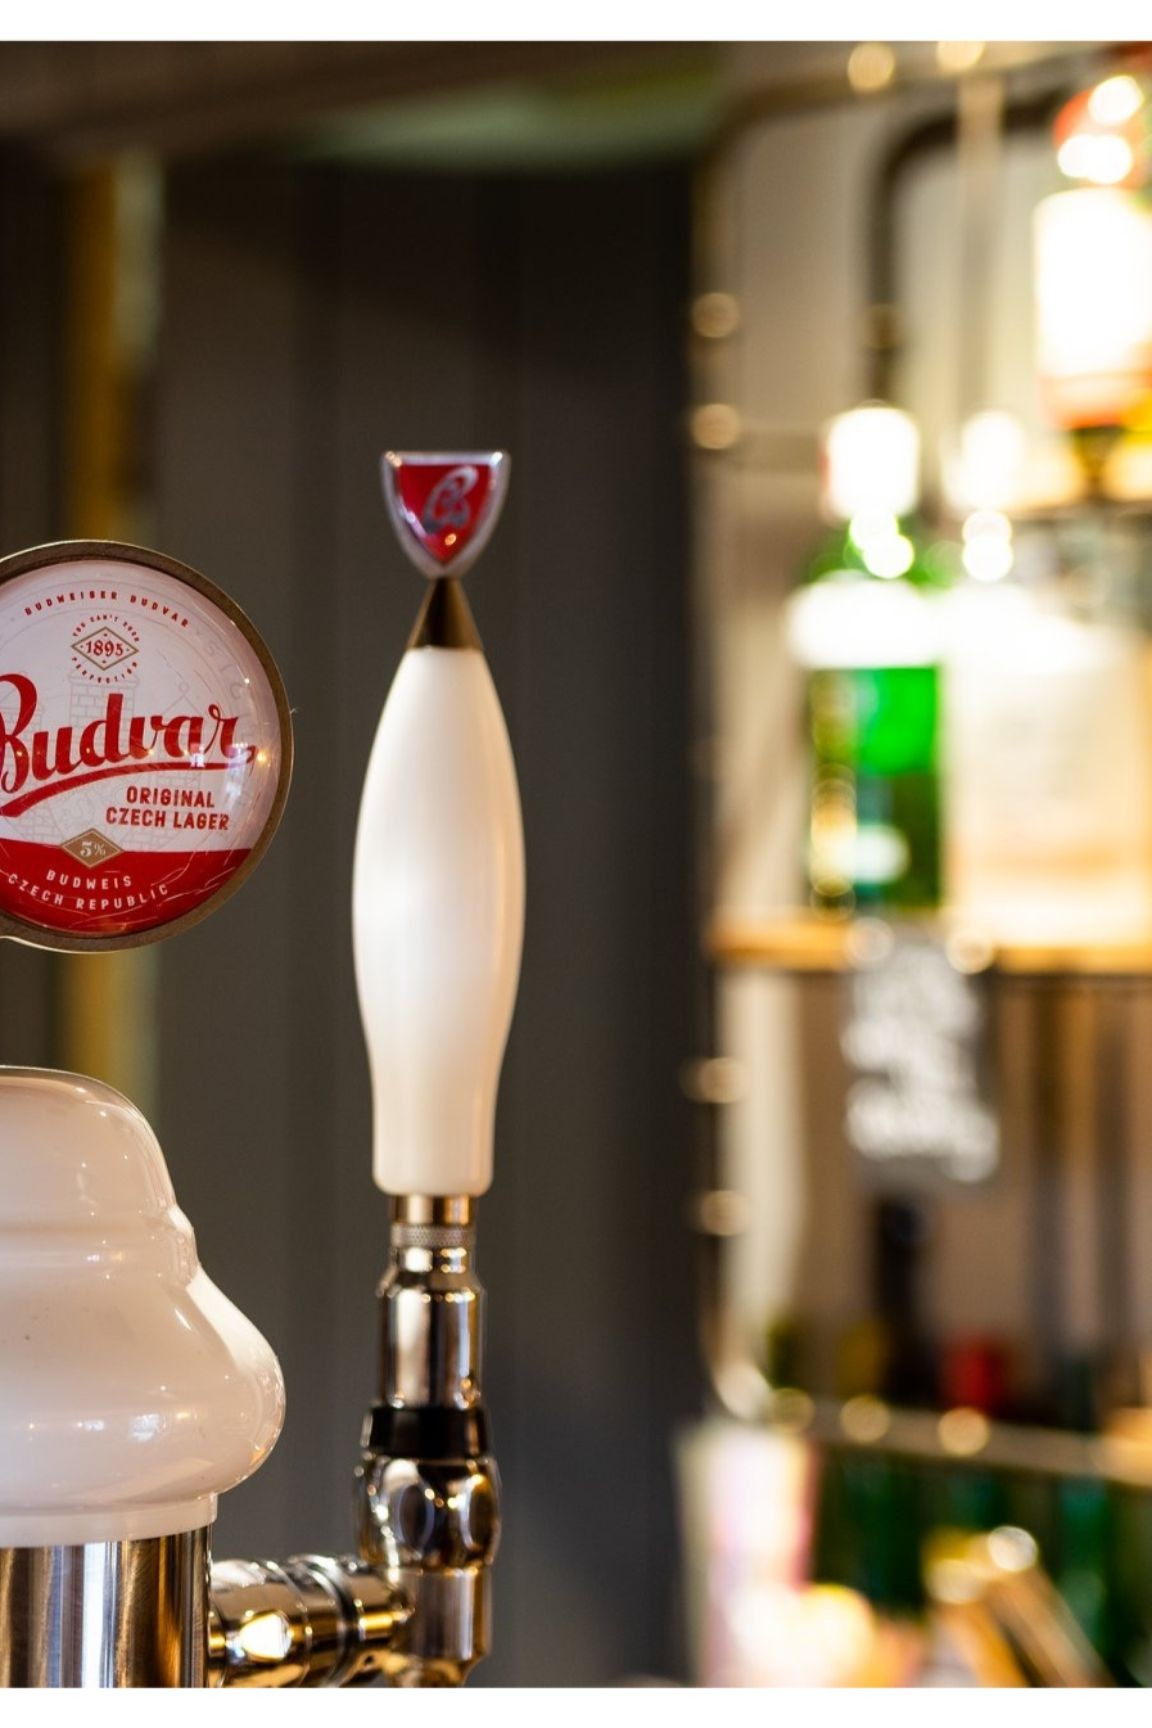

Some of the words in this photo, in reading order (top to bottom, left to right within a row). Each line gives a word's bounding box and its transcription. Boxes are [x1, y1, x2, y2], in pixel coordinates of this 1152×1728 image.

[24, 590, 118, 616] BUDWEISER
[130, 594, 189, 628] BUDVAR
[85, 639, 124, 657] 1895
[126, 785, 215, 808] ORIGINAL
[106, 806, 166, 828] CZECH
[173, 811, 230, 831] LAGER
[79, 840, 106, 858] 5%
[46, 869, 132, 890] BUDWEIS
[8, 873, 64, 906] CZECH
[76, 884, 168, 911] REPUBLIC
